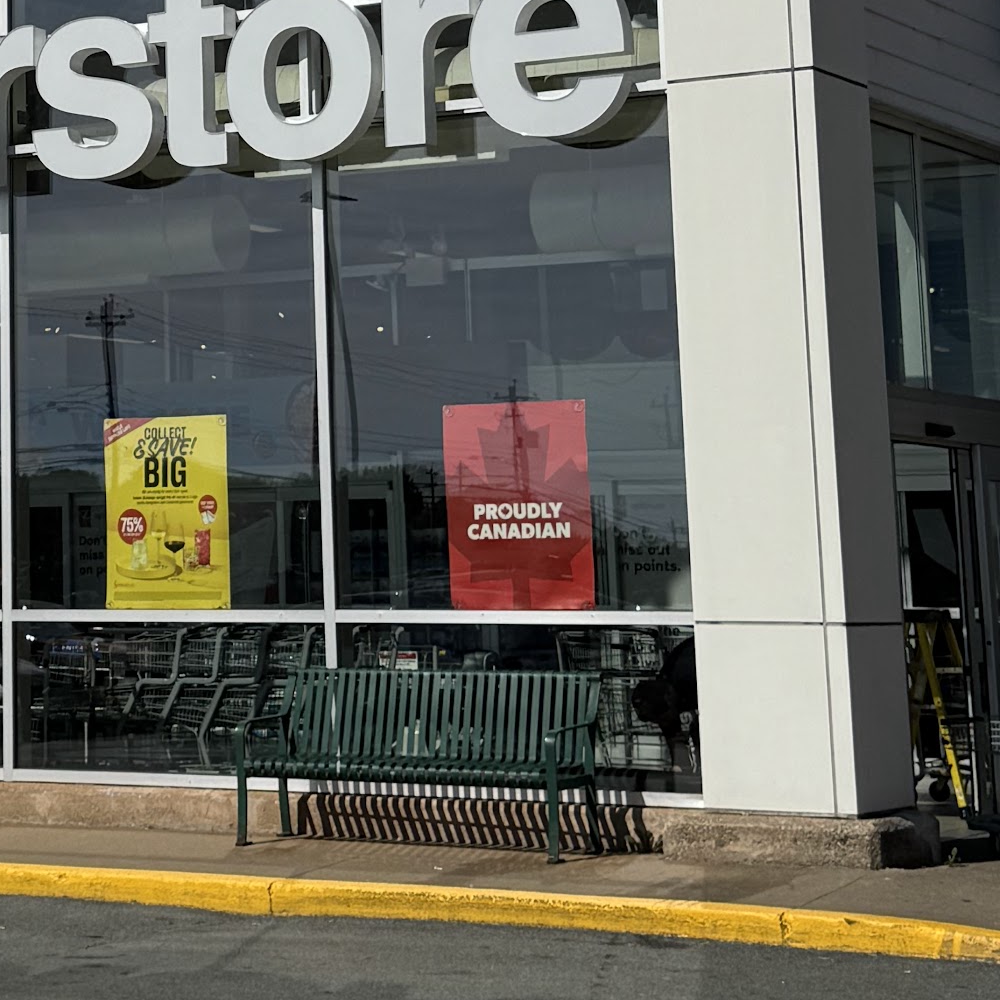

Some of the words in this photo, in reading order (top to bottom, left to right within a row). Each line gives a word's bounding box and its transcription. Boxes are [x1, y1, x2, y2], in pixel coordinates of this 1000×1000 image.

[144, 426, 187, 440] COLLECT
[147, 436, 198, 458] SAVE!
[144, 456, 187, 488] BIG
[473, 502, 563, 520] PROUDLY
[120, 516, 144, 533] 75%
[467, 522, 571, 540] CANADIAN
[79, 566, 93, 575] on
[634, 559, 682, 575] points.
